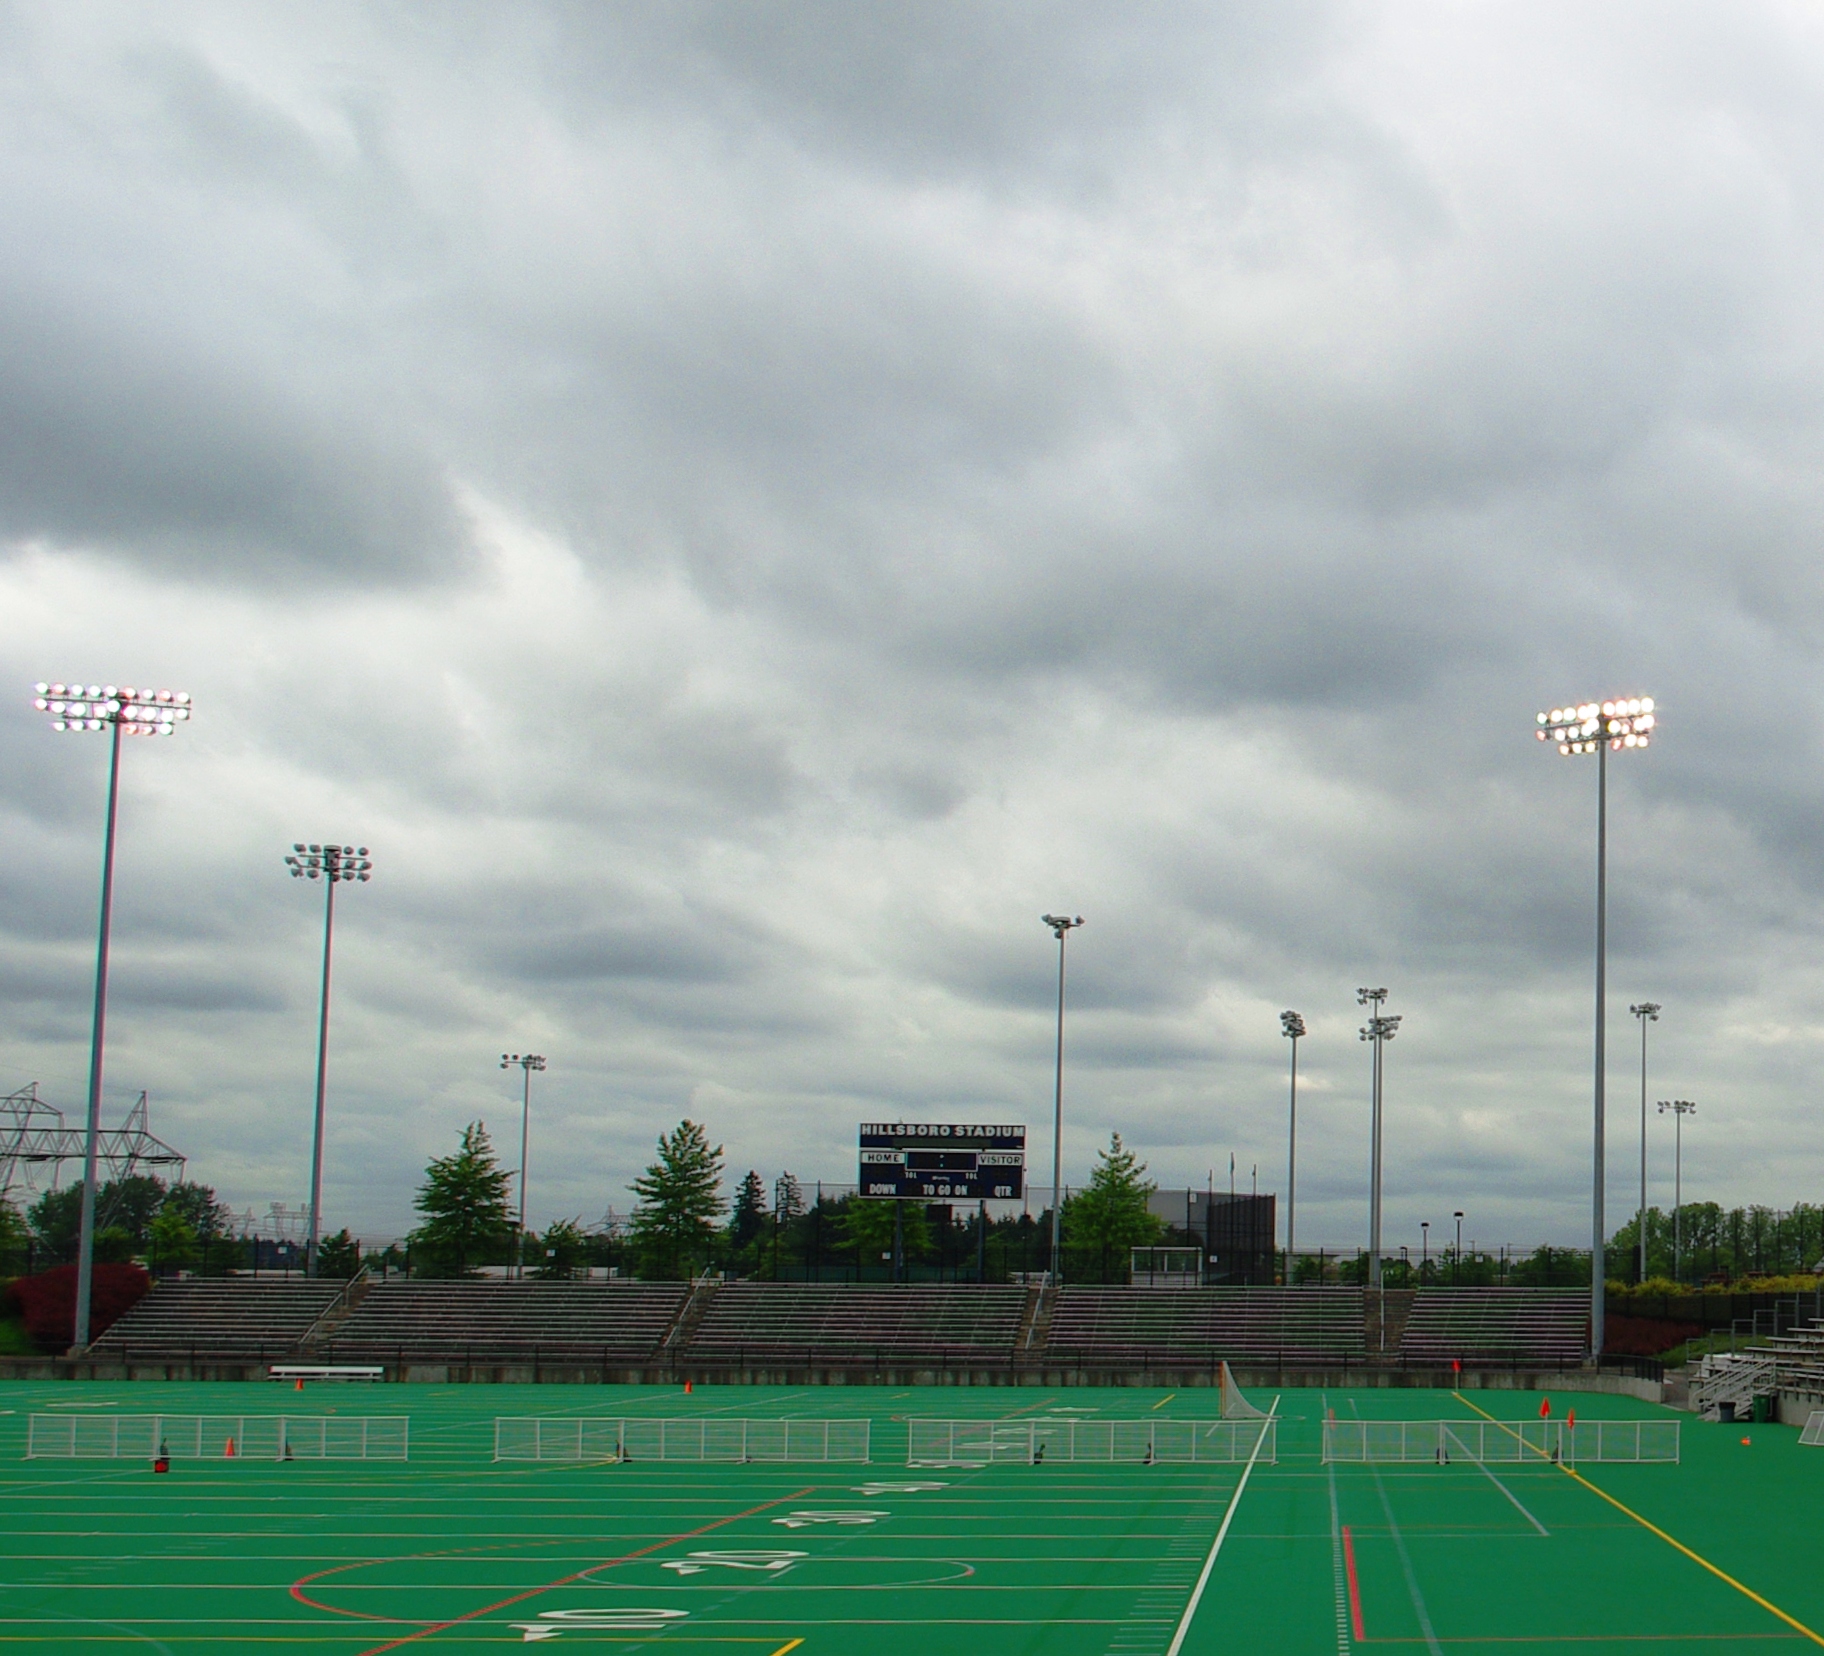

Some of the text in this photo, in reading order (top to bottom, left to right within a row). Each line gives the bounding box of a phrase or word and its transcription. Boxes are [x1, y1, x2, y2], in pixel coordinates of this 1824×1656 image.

[861, 1124, 1024, 1137] HILLSBORO STADIUM
[868, 1154, 900, 1162] HOME
[980, 1156, 1020, 1164] VISITOR
[869, 1183, 897, 1195] DOWN
[923, 1184, 968, 1196] TO GO ON
[994, 1185, 1013, 1197] QTR
[660, 1550, 810, 1573] 20
[508, 1608, 690, 1632] 10
